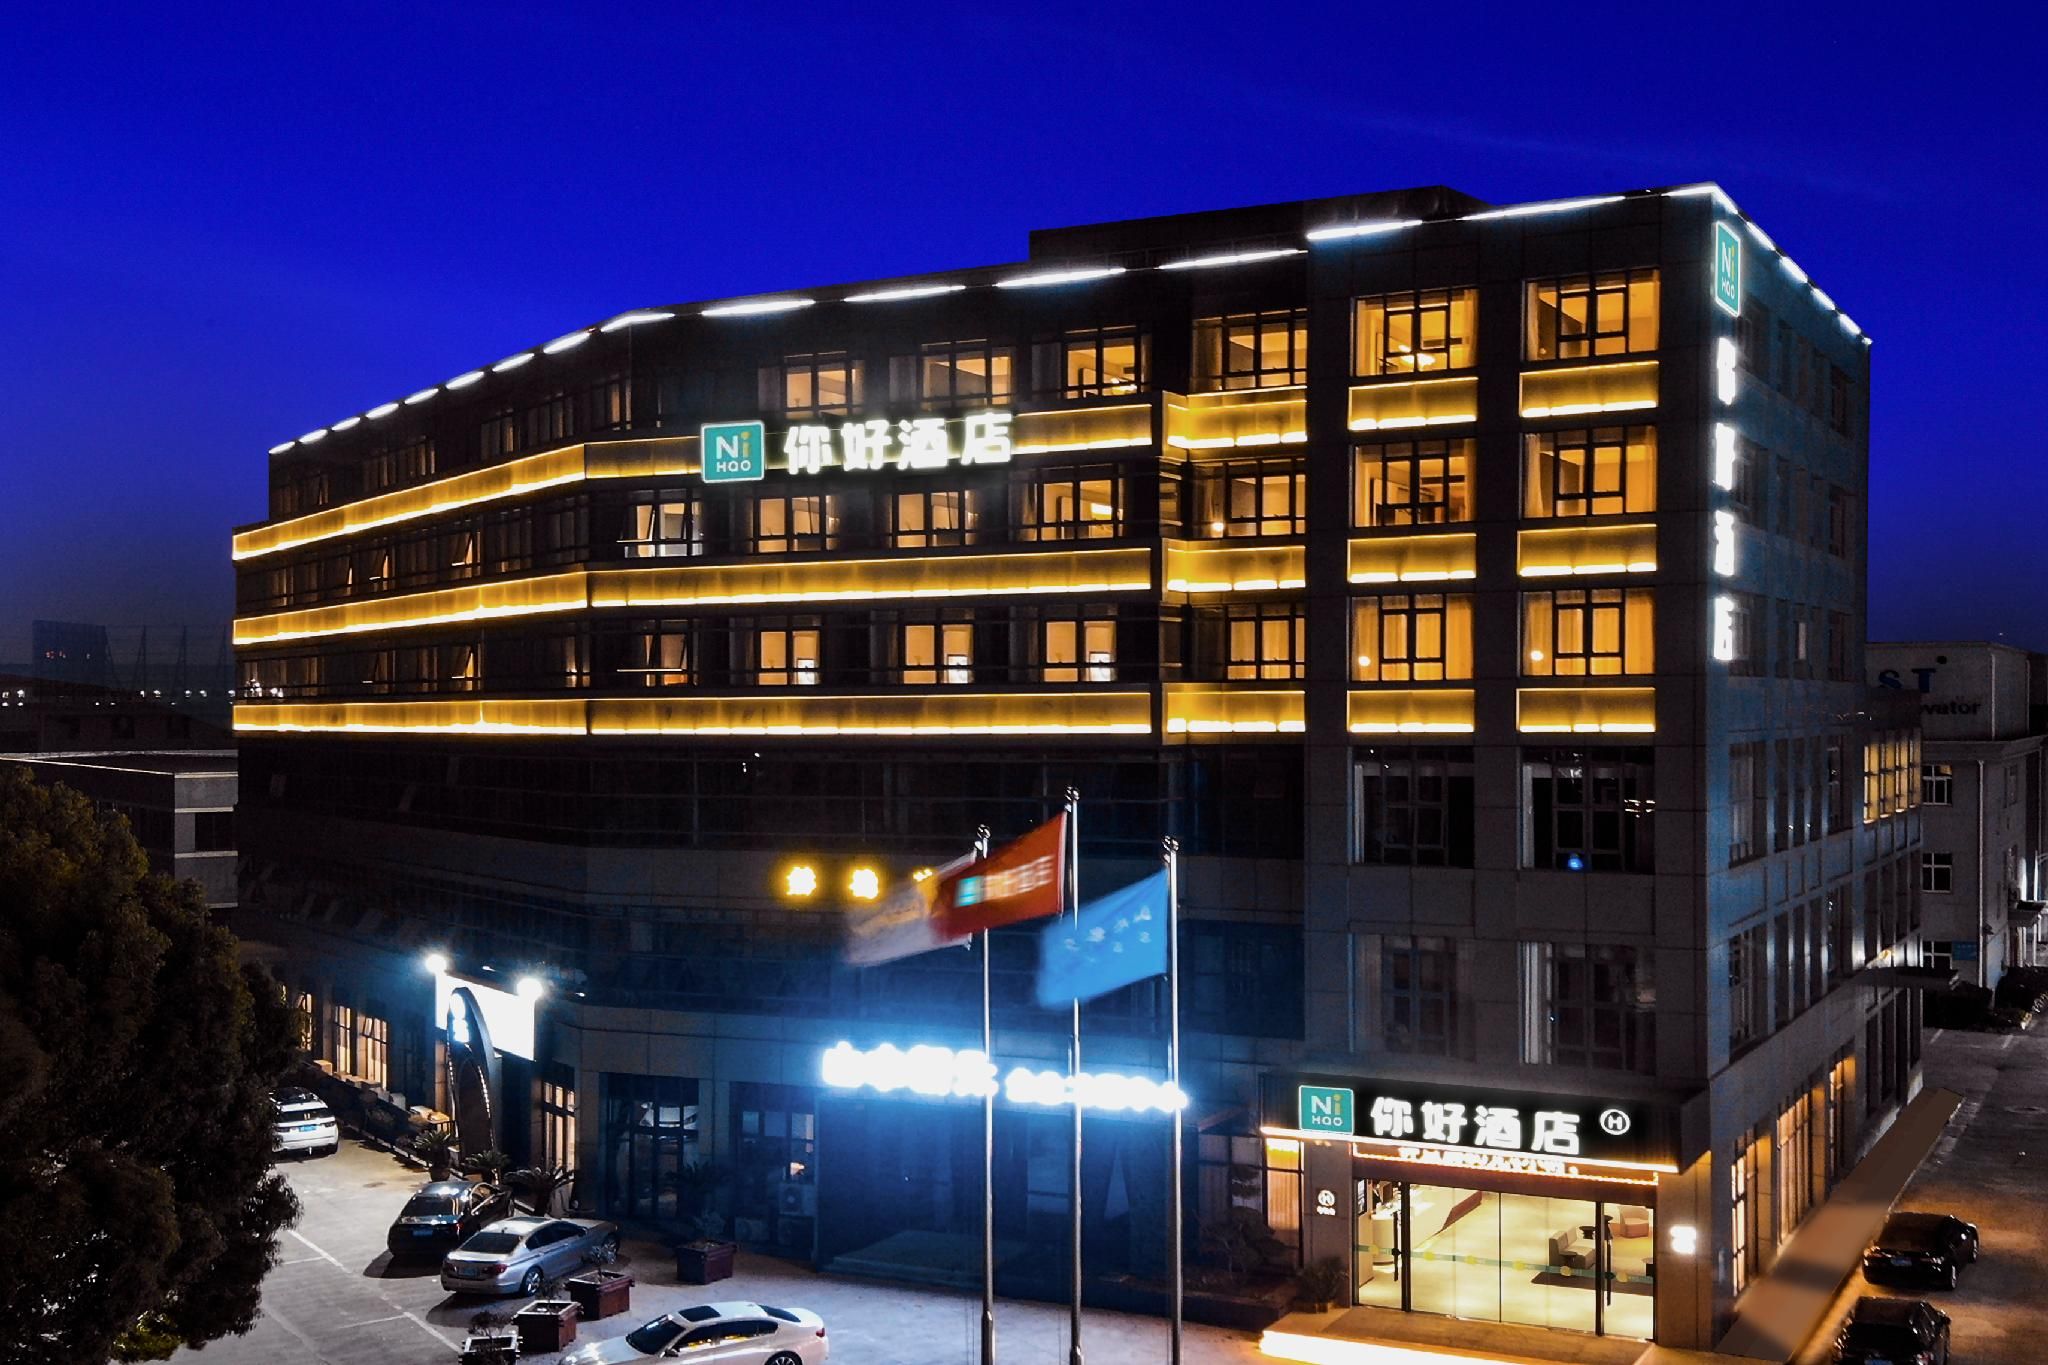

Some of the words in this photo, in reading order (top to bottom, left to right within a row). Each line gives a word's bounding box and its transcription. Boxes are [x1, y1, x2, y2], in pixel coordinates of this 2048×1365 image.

[1721, 241, 1735, 282] Ni
[716, 431, 751, 459] Ni
[784, 412, 1013, 475] 你好酒店
[1311, 1093, 1342, 1115] Ni
[1370, 1096, 1581, 1156] 你好酒店
